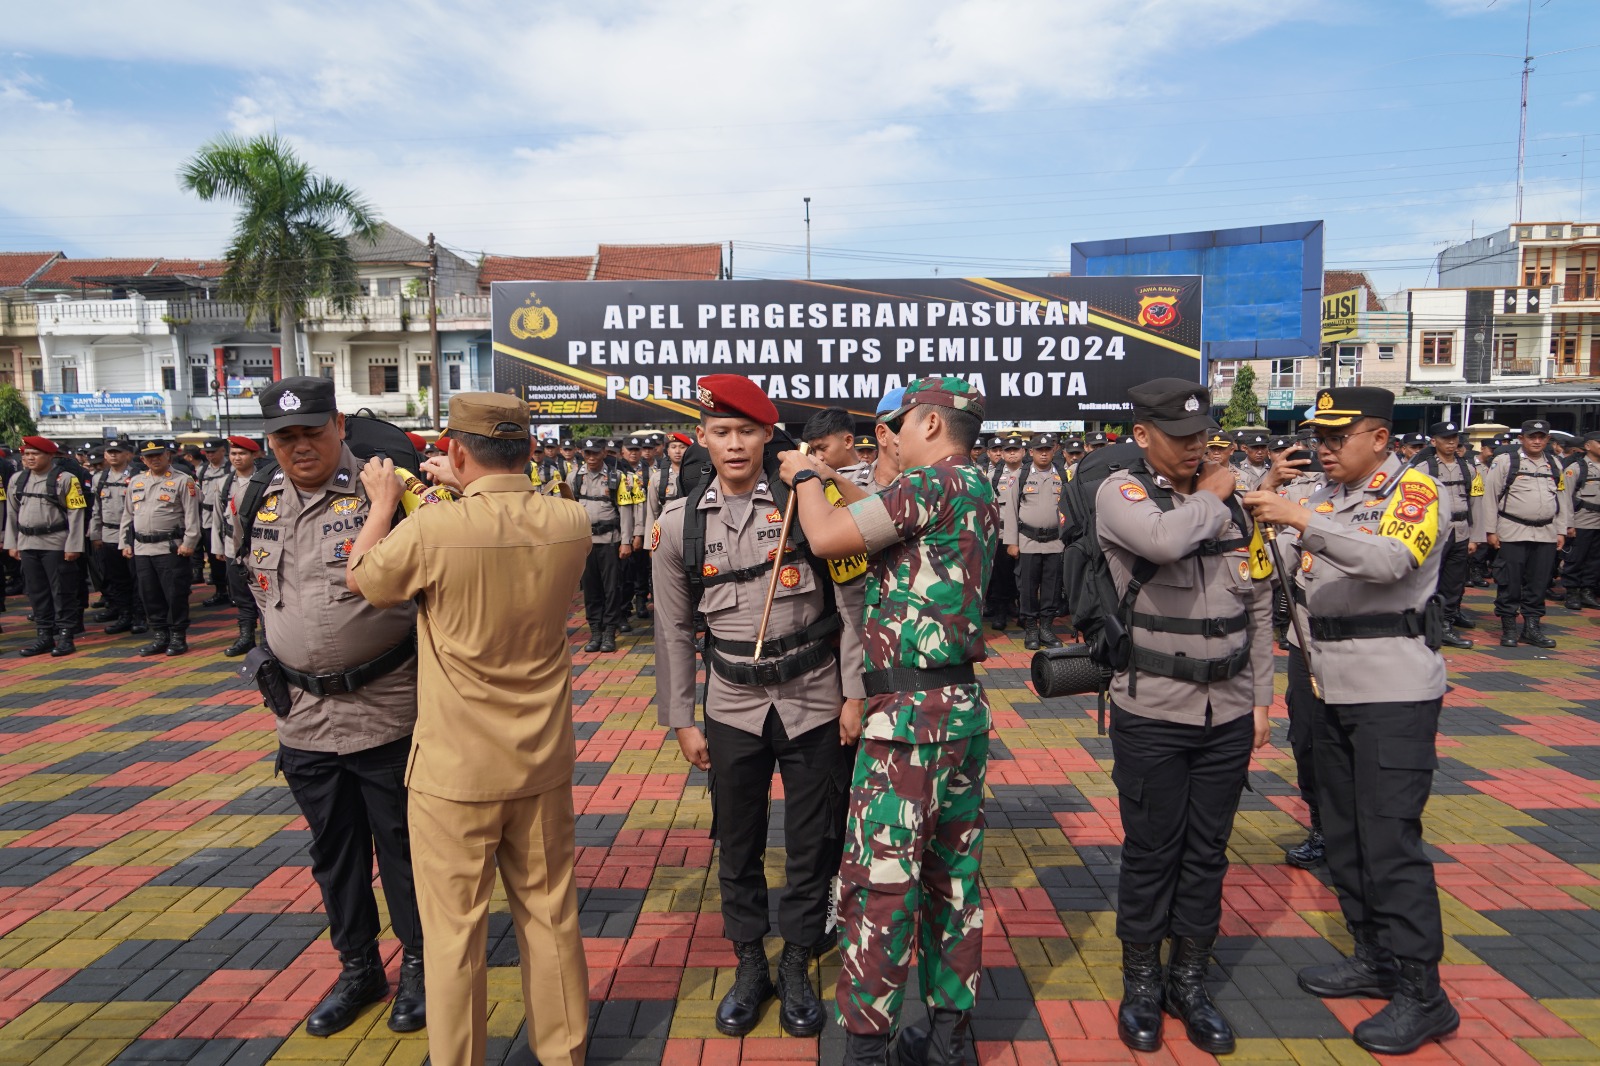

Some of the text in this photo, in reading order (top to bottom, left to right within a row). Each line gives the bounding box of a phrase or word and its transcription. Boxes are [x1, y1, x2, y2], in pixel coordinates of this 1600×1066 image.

[1139, 286, 1157, 294] JAWA
[603, 301, 1088, 330] APEL PERGESERAN PASUKAN
[568, 335, 1126, 365] PENGAMANAN TPS PEMILU 2024
[606, 371, 1088, 400] POLR TASIKMAA KOTA
[72, 397, 103, 405] KANTOR
[578, 392, 597, 400] YANG
[1122, 402, 1130, 410] 12
[1386, 520, 1415, 540] OPS
